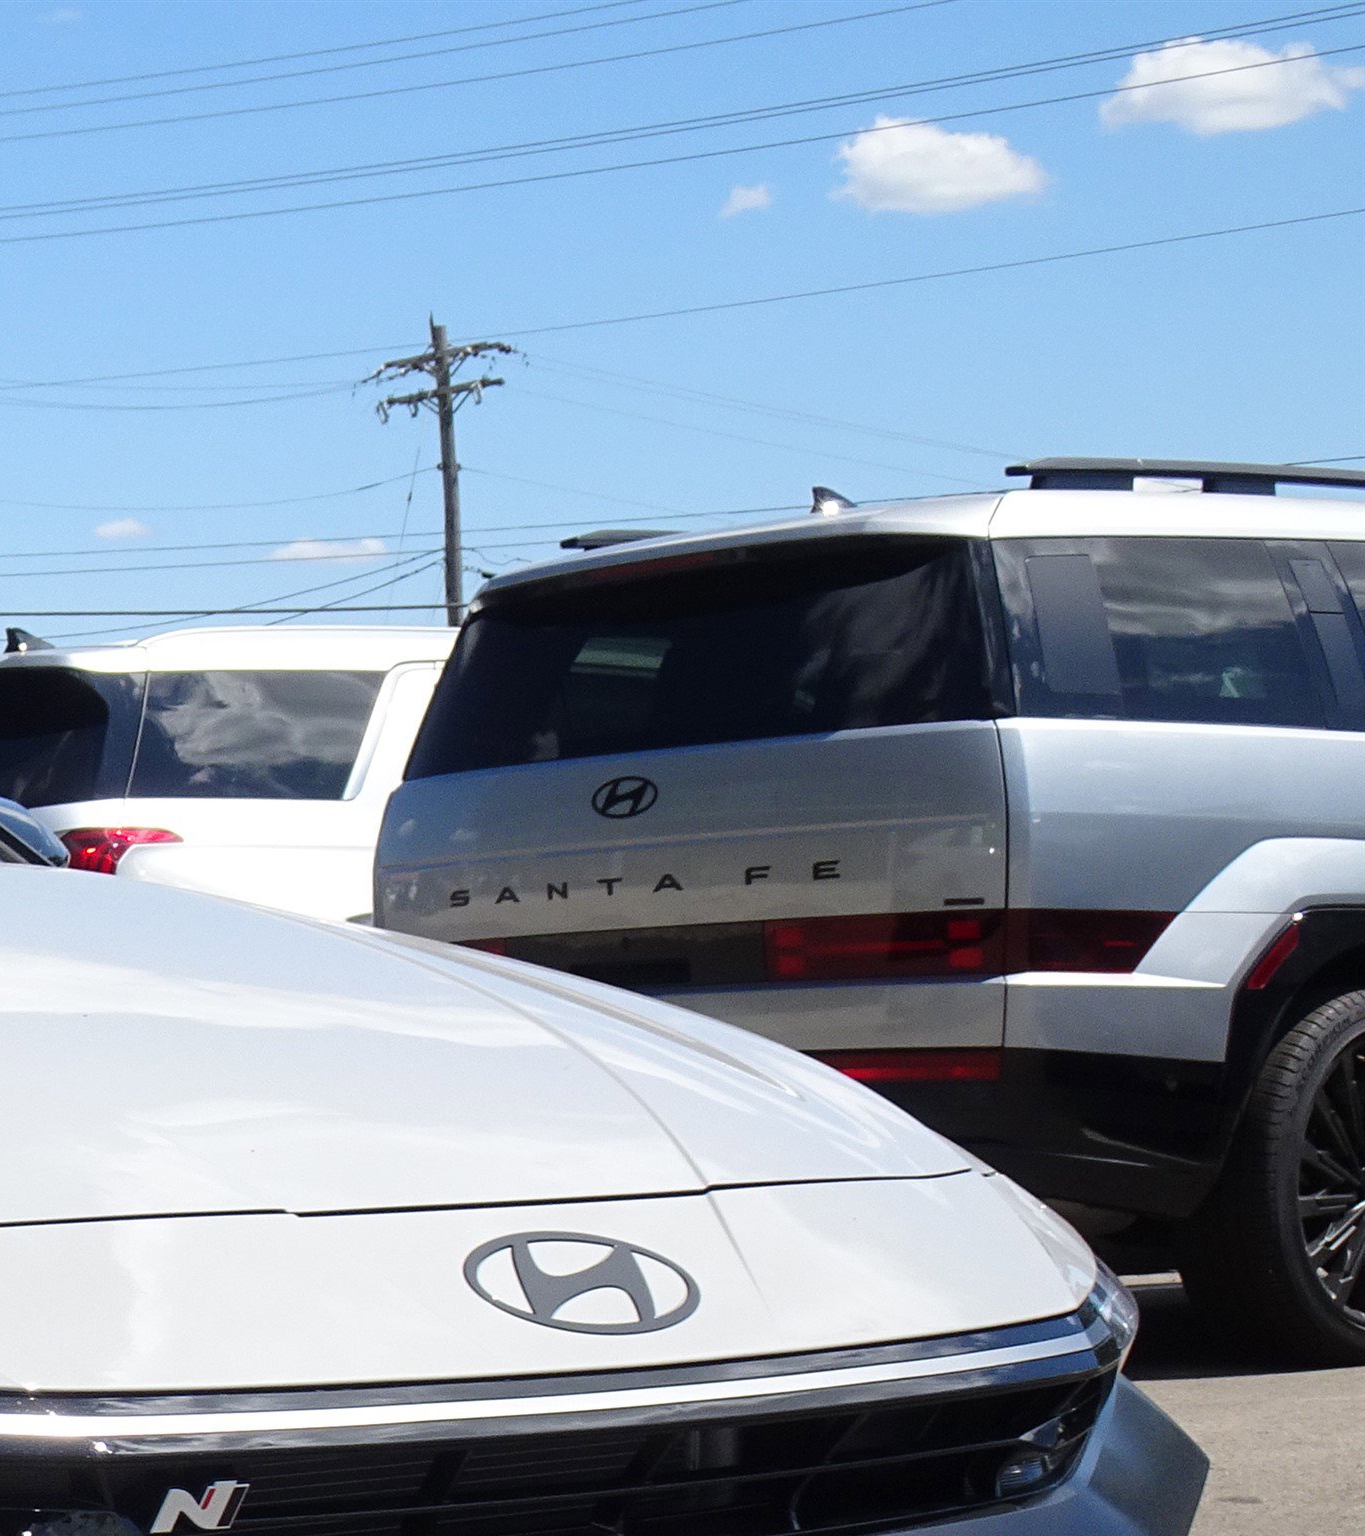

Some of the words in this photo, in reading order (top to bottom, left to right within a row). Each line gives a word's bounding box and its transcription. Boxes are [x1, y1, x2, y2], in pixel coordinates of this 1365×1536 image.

[449, 873, 684, 908] SANTA
[744, 860, 841, 886] FE
[149, 1479, 251, 1534] N
